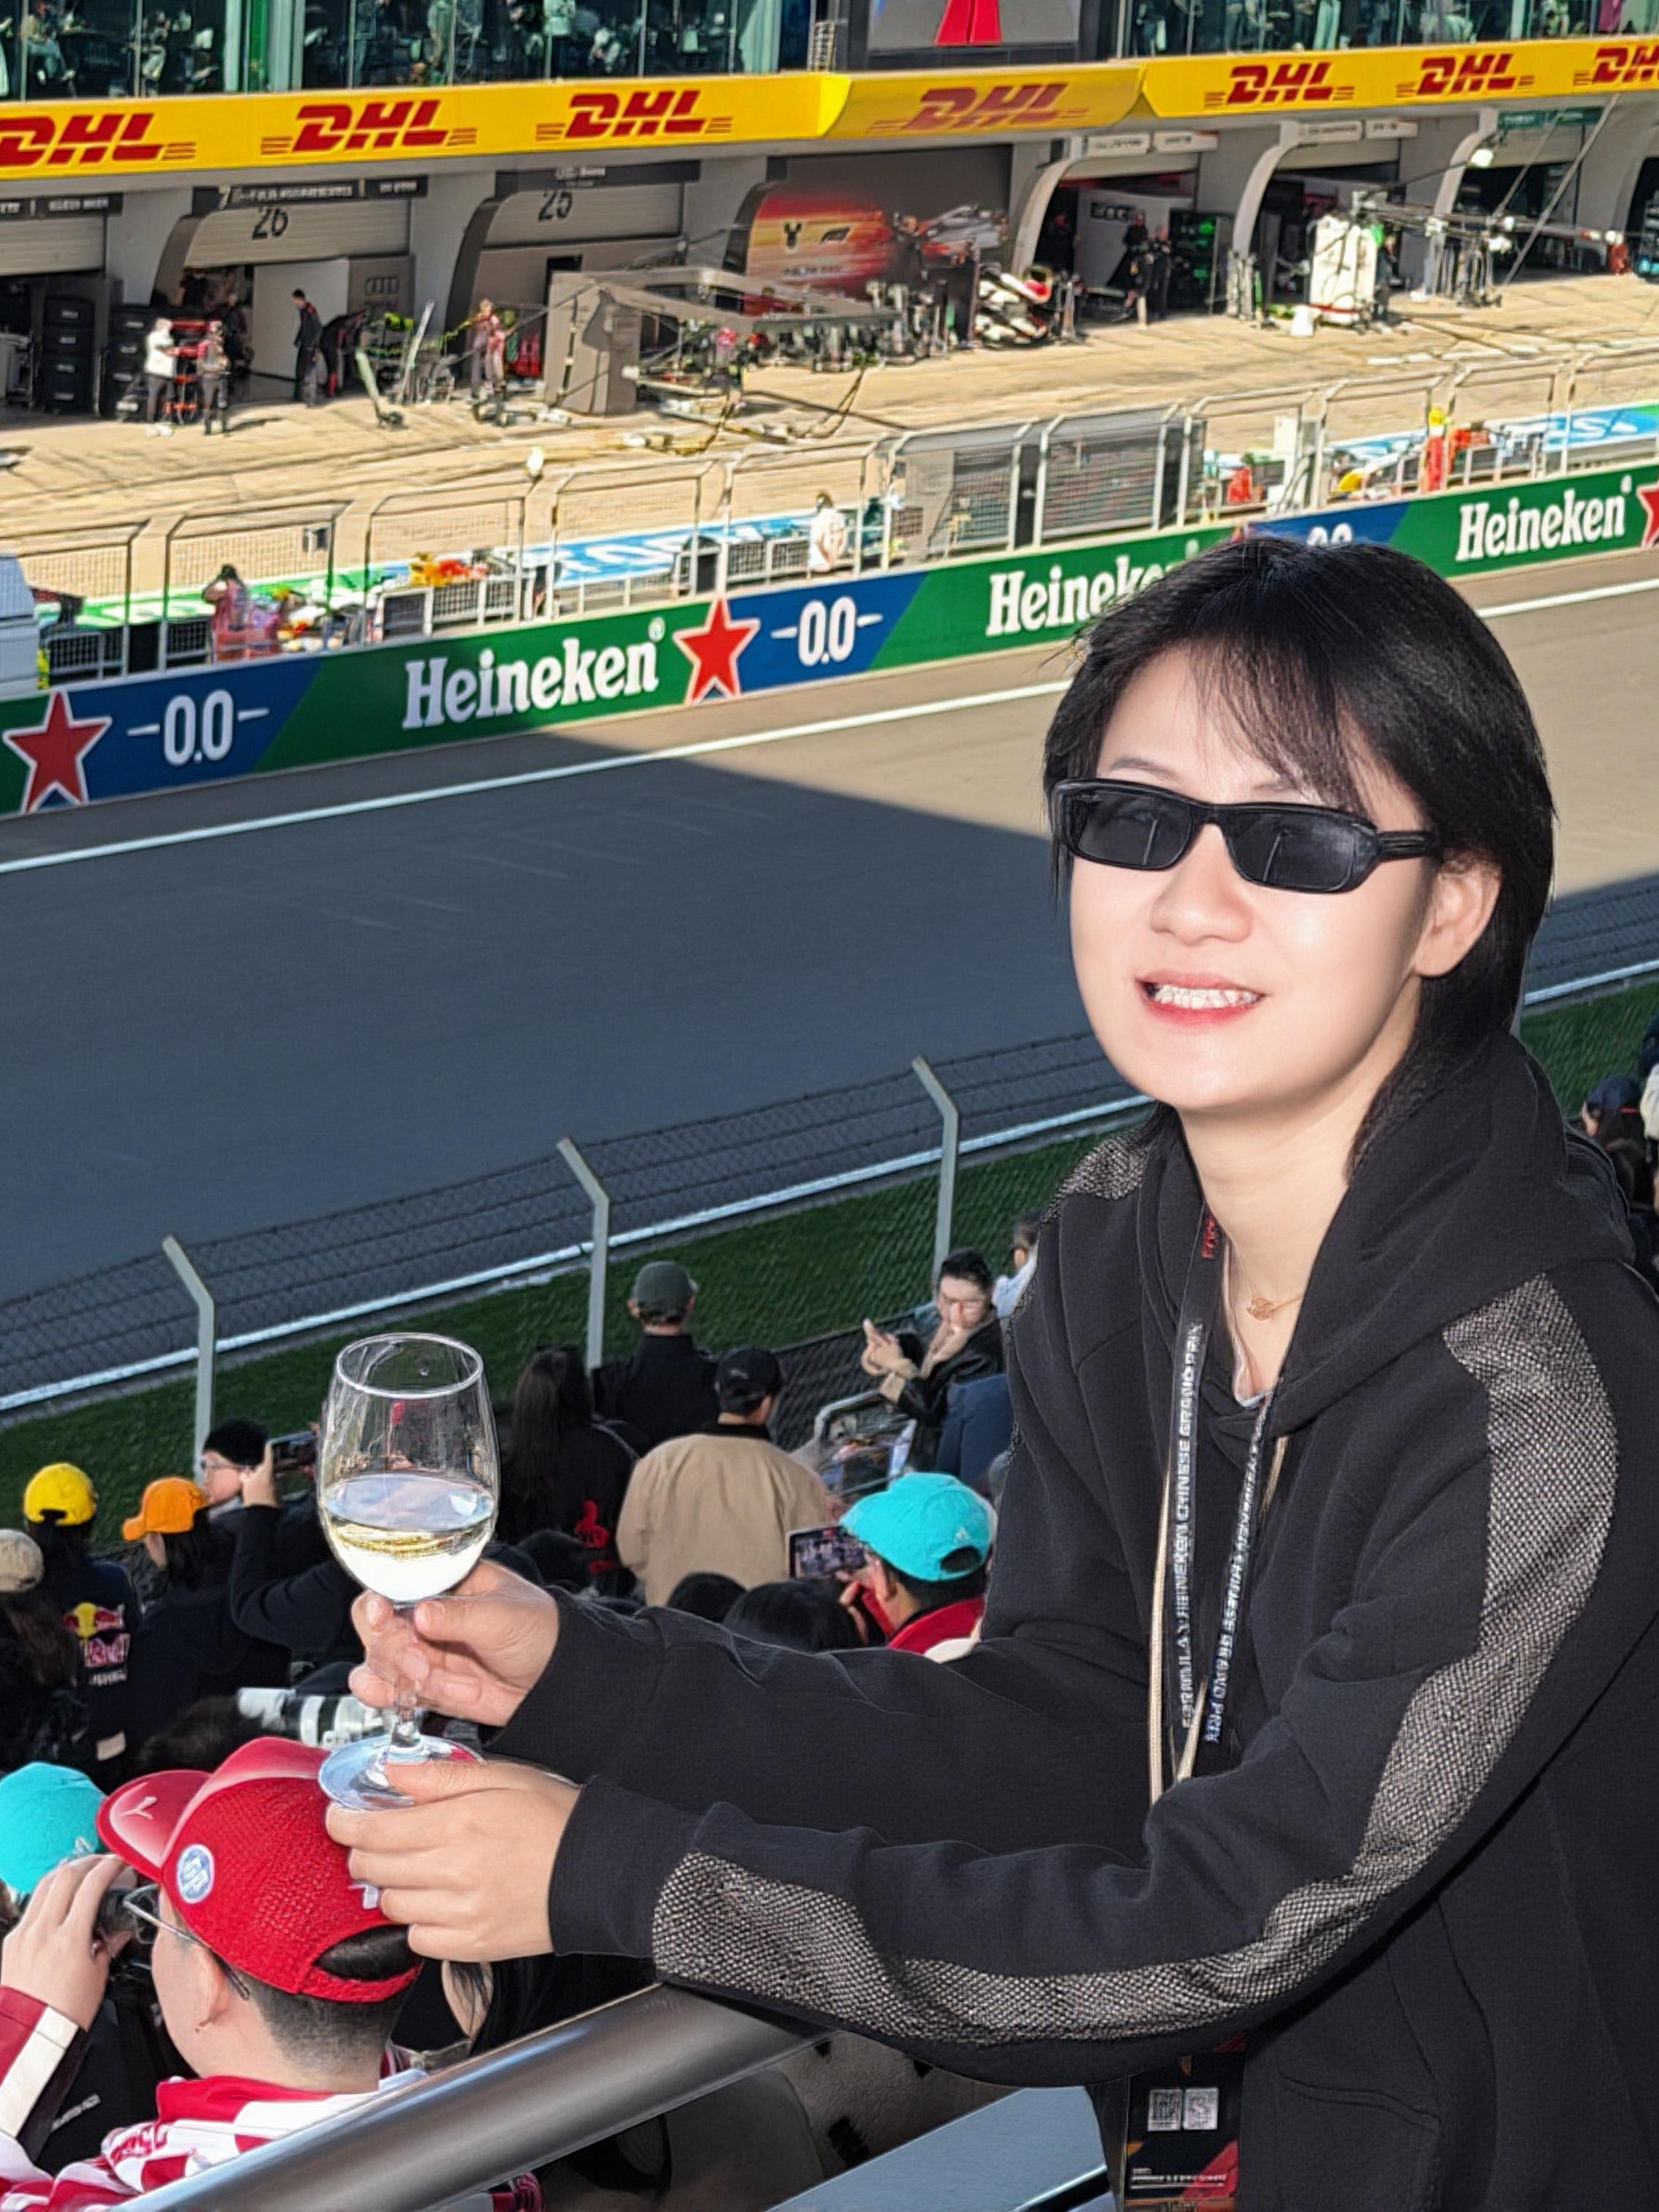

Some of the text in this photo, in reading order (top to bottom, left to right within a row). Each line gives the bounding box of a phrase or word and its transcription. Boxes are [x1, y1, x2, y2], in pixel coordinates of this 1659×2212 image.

[1226, 62, 1334, 104] DHL
[1416, 53, 1516, 95] DHL
[1592, 45, 1659, 83] DH
[292, 99, 448, 152] DHL
[565, 90, 705, 138] DHL
[900, 83, 1068, 130] DHL
[0, 113, 159, 166] DHL
[252, 207, 289, 240] 26
[538, 190, 573, 222] 25
[1185, 1320, 1205, 1365] PRIX
[1179, 1366, 1195, 1437] GRAND
[1176, 1440, 1190, 1522] CHINESE
[1212, 1633, 1233, 1699] GRAND
